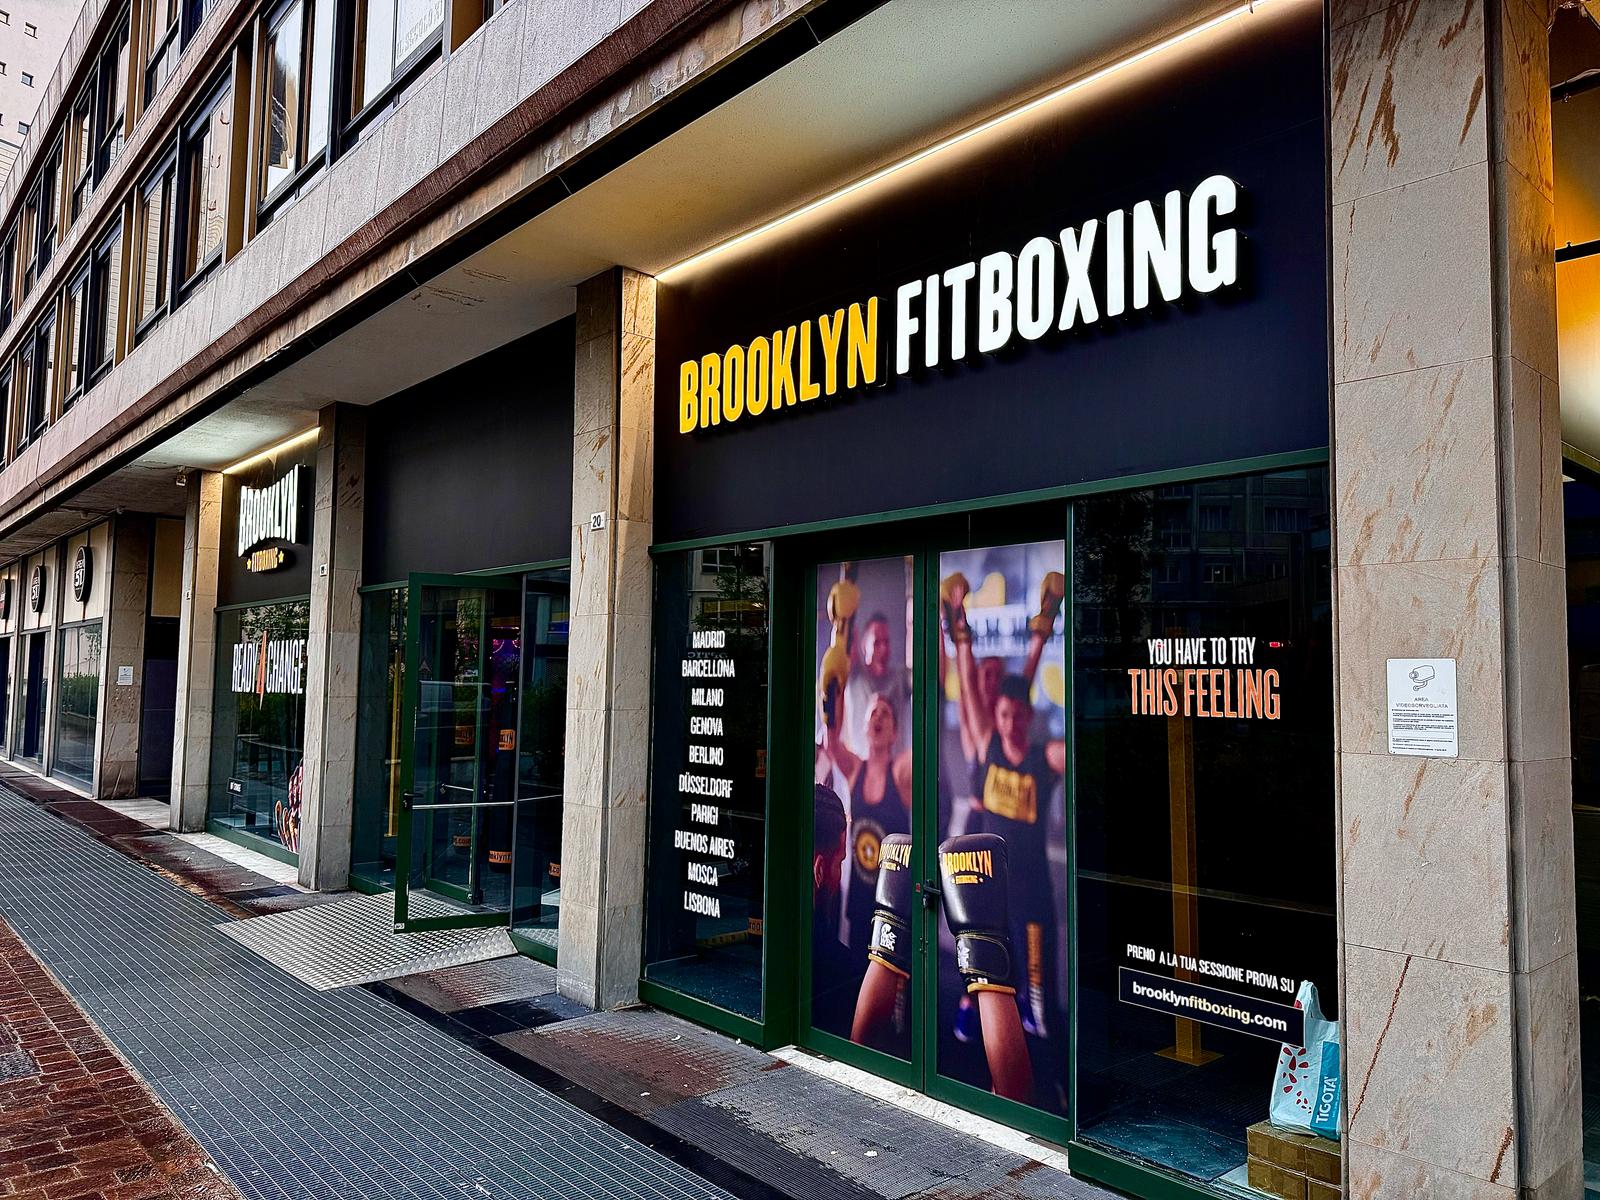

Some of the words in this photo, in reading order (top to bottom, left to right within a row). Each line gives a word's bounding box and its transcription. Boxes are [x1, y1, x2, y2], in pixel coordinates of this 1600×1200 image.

[680, 296, 878, 433] BROOKLYN
[896, 174, 1238, 375] FITBOXING
[238, 463, 299, 557] BROOKLYN
[592, 514, 602, 528] 20
[692, 630, 726, 649] MADRID
[1147, 638, 1172, 665] YOU
[1175, 637, 1207, 665] HAVE
[1210, 637, 1227, 665] TO
[1229, 636, 1256, 665] TRY
[231, 642, 259, 693] READY
[266, 638, 305, 695] CHANGE
[681, 659, 736, 678] BARCELLONA
[691, 688, 724, 707] MILANO
[1127, 668, 1178, 716] THIS
[1183, 668, 1281, 720] FEELING
[690, 716, 724, 736] GENOVA
[689, 745, 724, 766] BERLINO
[678, 772, 733, 798] DÜSSELDORF
[691, 803, 718, 825] PARIGI
[674, 829, 708, 854] BUENOS
[709, 836, 735, 859] AIRES
[687, 861, 719, 887] MOSCA
[942, 850, 993, 880] BROOKLYN
[683, 890, 721, 919] LISBONA
[1167, 952, 1178, 968] LA
[1180, 955, 1197, 972] TUA
[1199, 959, 1244, 983] SESSIONE
[1246, 969, 1278, 991] PROVA
[1280, 977, 1295, 994] SU
[1132, 981, 1288, 1032] brooklynfitboxing.com
